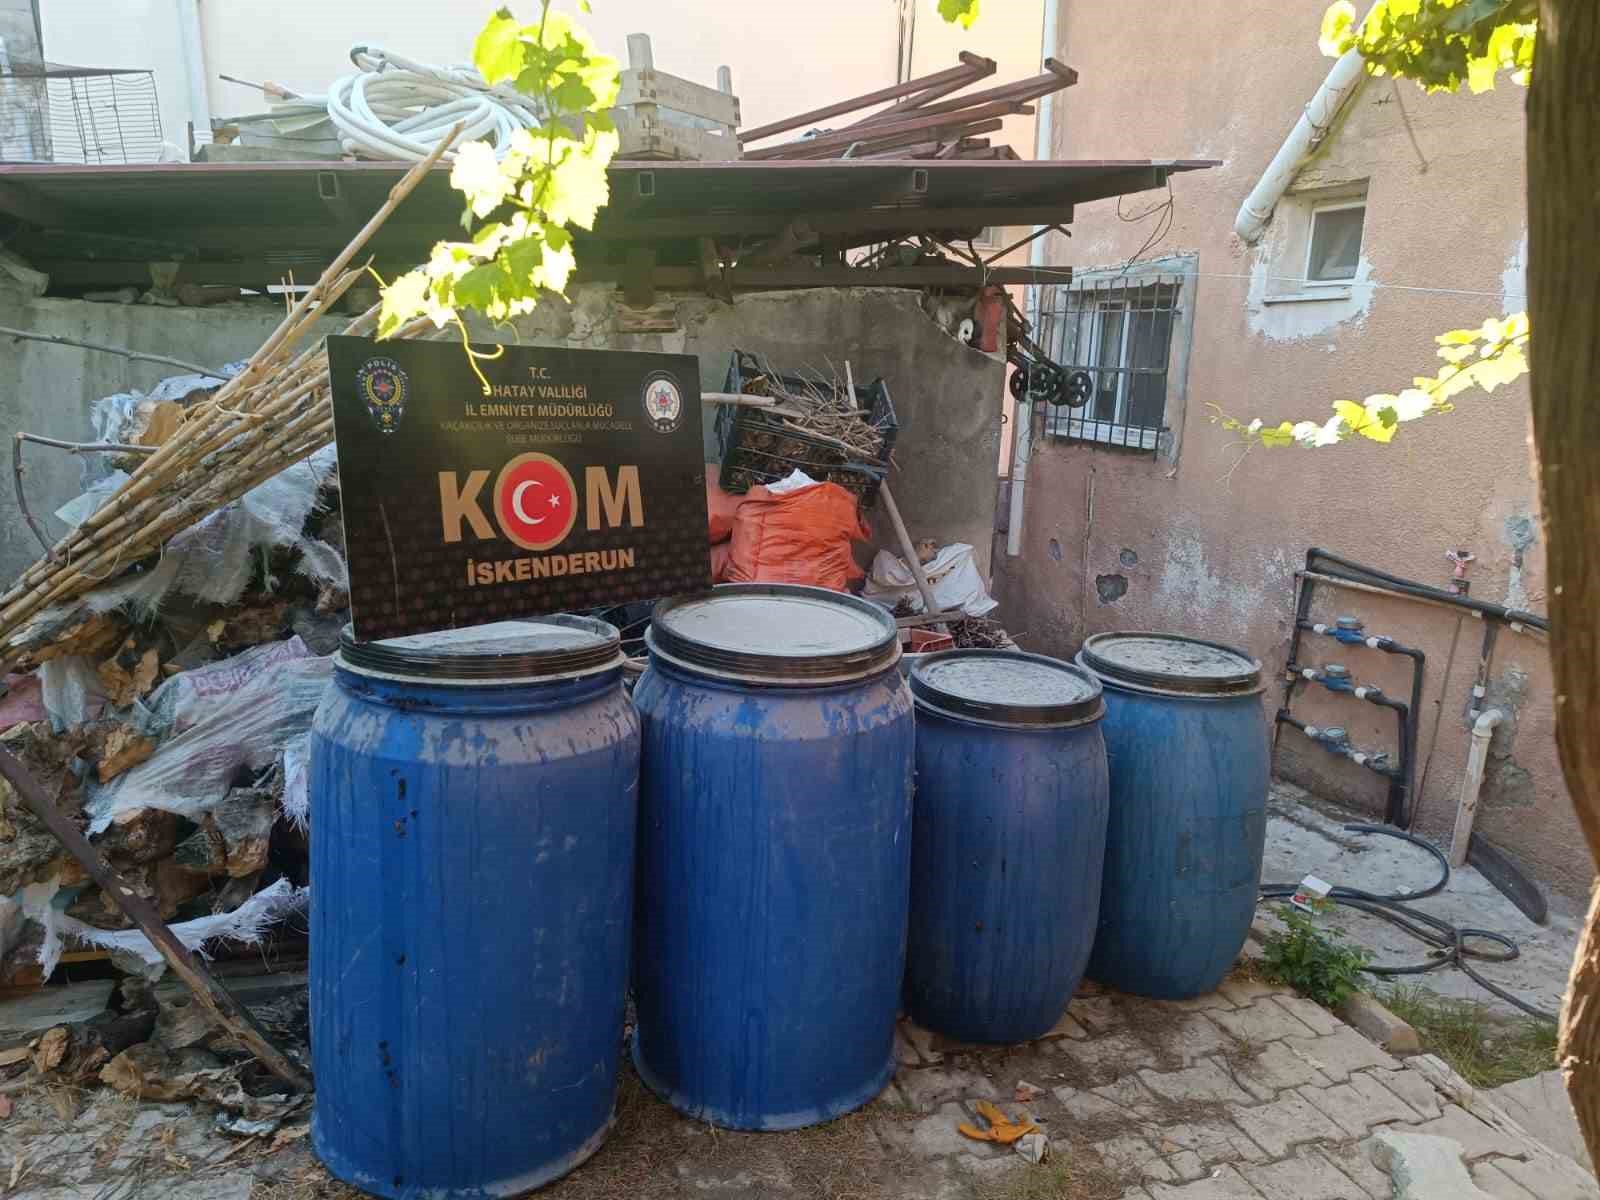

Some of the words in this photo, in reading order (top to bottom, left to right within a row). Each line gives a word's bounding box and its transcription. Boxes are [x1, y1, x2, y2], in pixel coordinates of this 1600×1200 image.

[528, 366, 552, 379] T.C.
[493, 384, 536, 398] HATAY
[465, 402, 478, 416] İL
[480, 402, 534, 417] EMNİYET
[538, 402, 613, 417] MÜDÜRLÜĞÜ
[438, 452, 644, 550] KOM
[466, 547, 636, 587] İSKENDERUN
